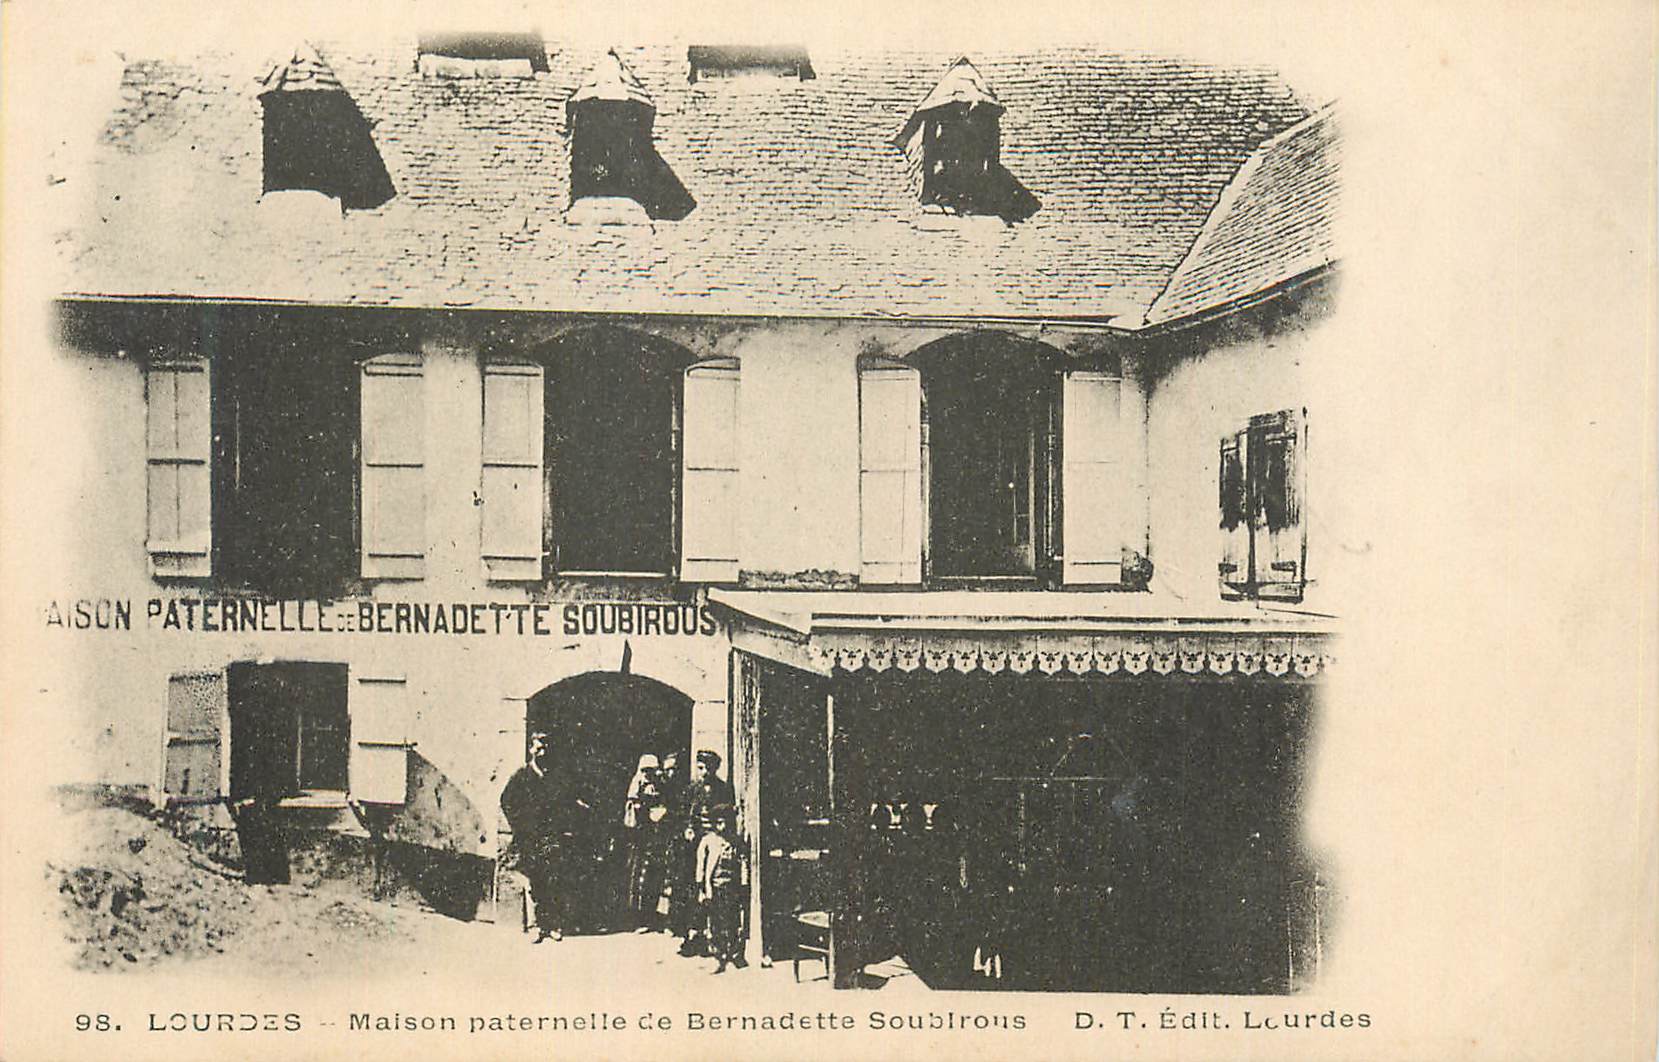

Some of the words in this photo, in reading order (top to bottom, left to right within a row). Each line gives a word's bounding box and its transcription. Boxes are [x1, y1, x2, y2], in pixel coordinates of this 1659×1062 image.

[147, 598, 333, 632] PATERNELLE
[359, 602, 550, 635] BERNADETTE
[563, 603, 716, 635] SOUBIROUS
